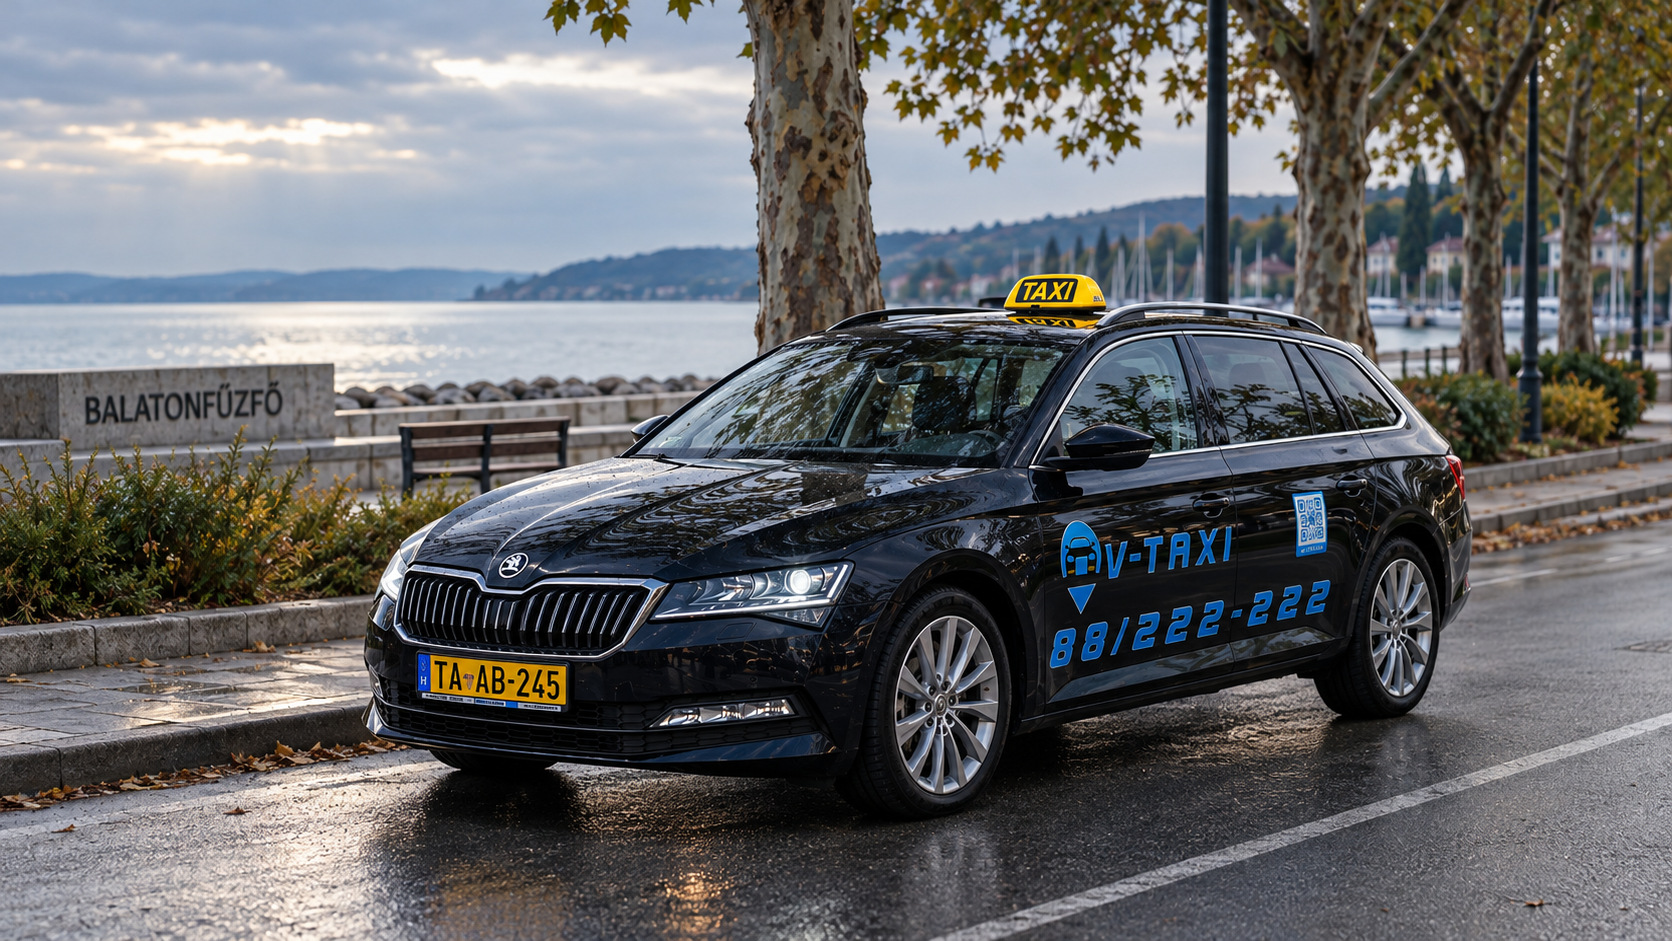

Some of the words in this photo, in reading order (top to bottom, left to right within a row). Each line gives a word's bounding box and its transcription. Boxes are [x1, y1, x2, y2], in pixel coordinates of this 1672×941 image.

[1023, 281, 1075, 301] TAXI
[85, 381, 283, 425] BALATONFŰZFŐ
[1105, 526, 1232, 579] V-TAXI
[1050, 580, 1331, 668] 88/222-222
[420, 675, 427, 686] H
[434, 660, 462, 691] TA
[475, 664, 560, 700] AB-245
